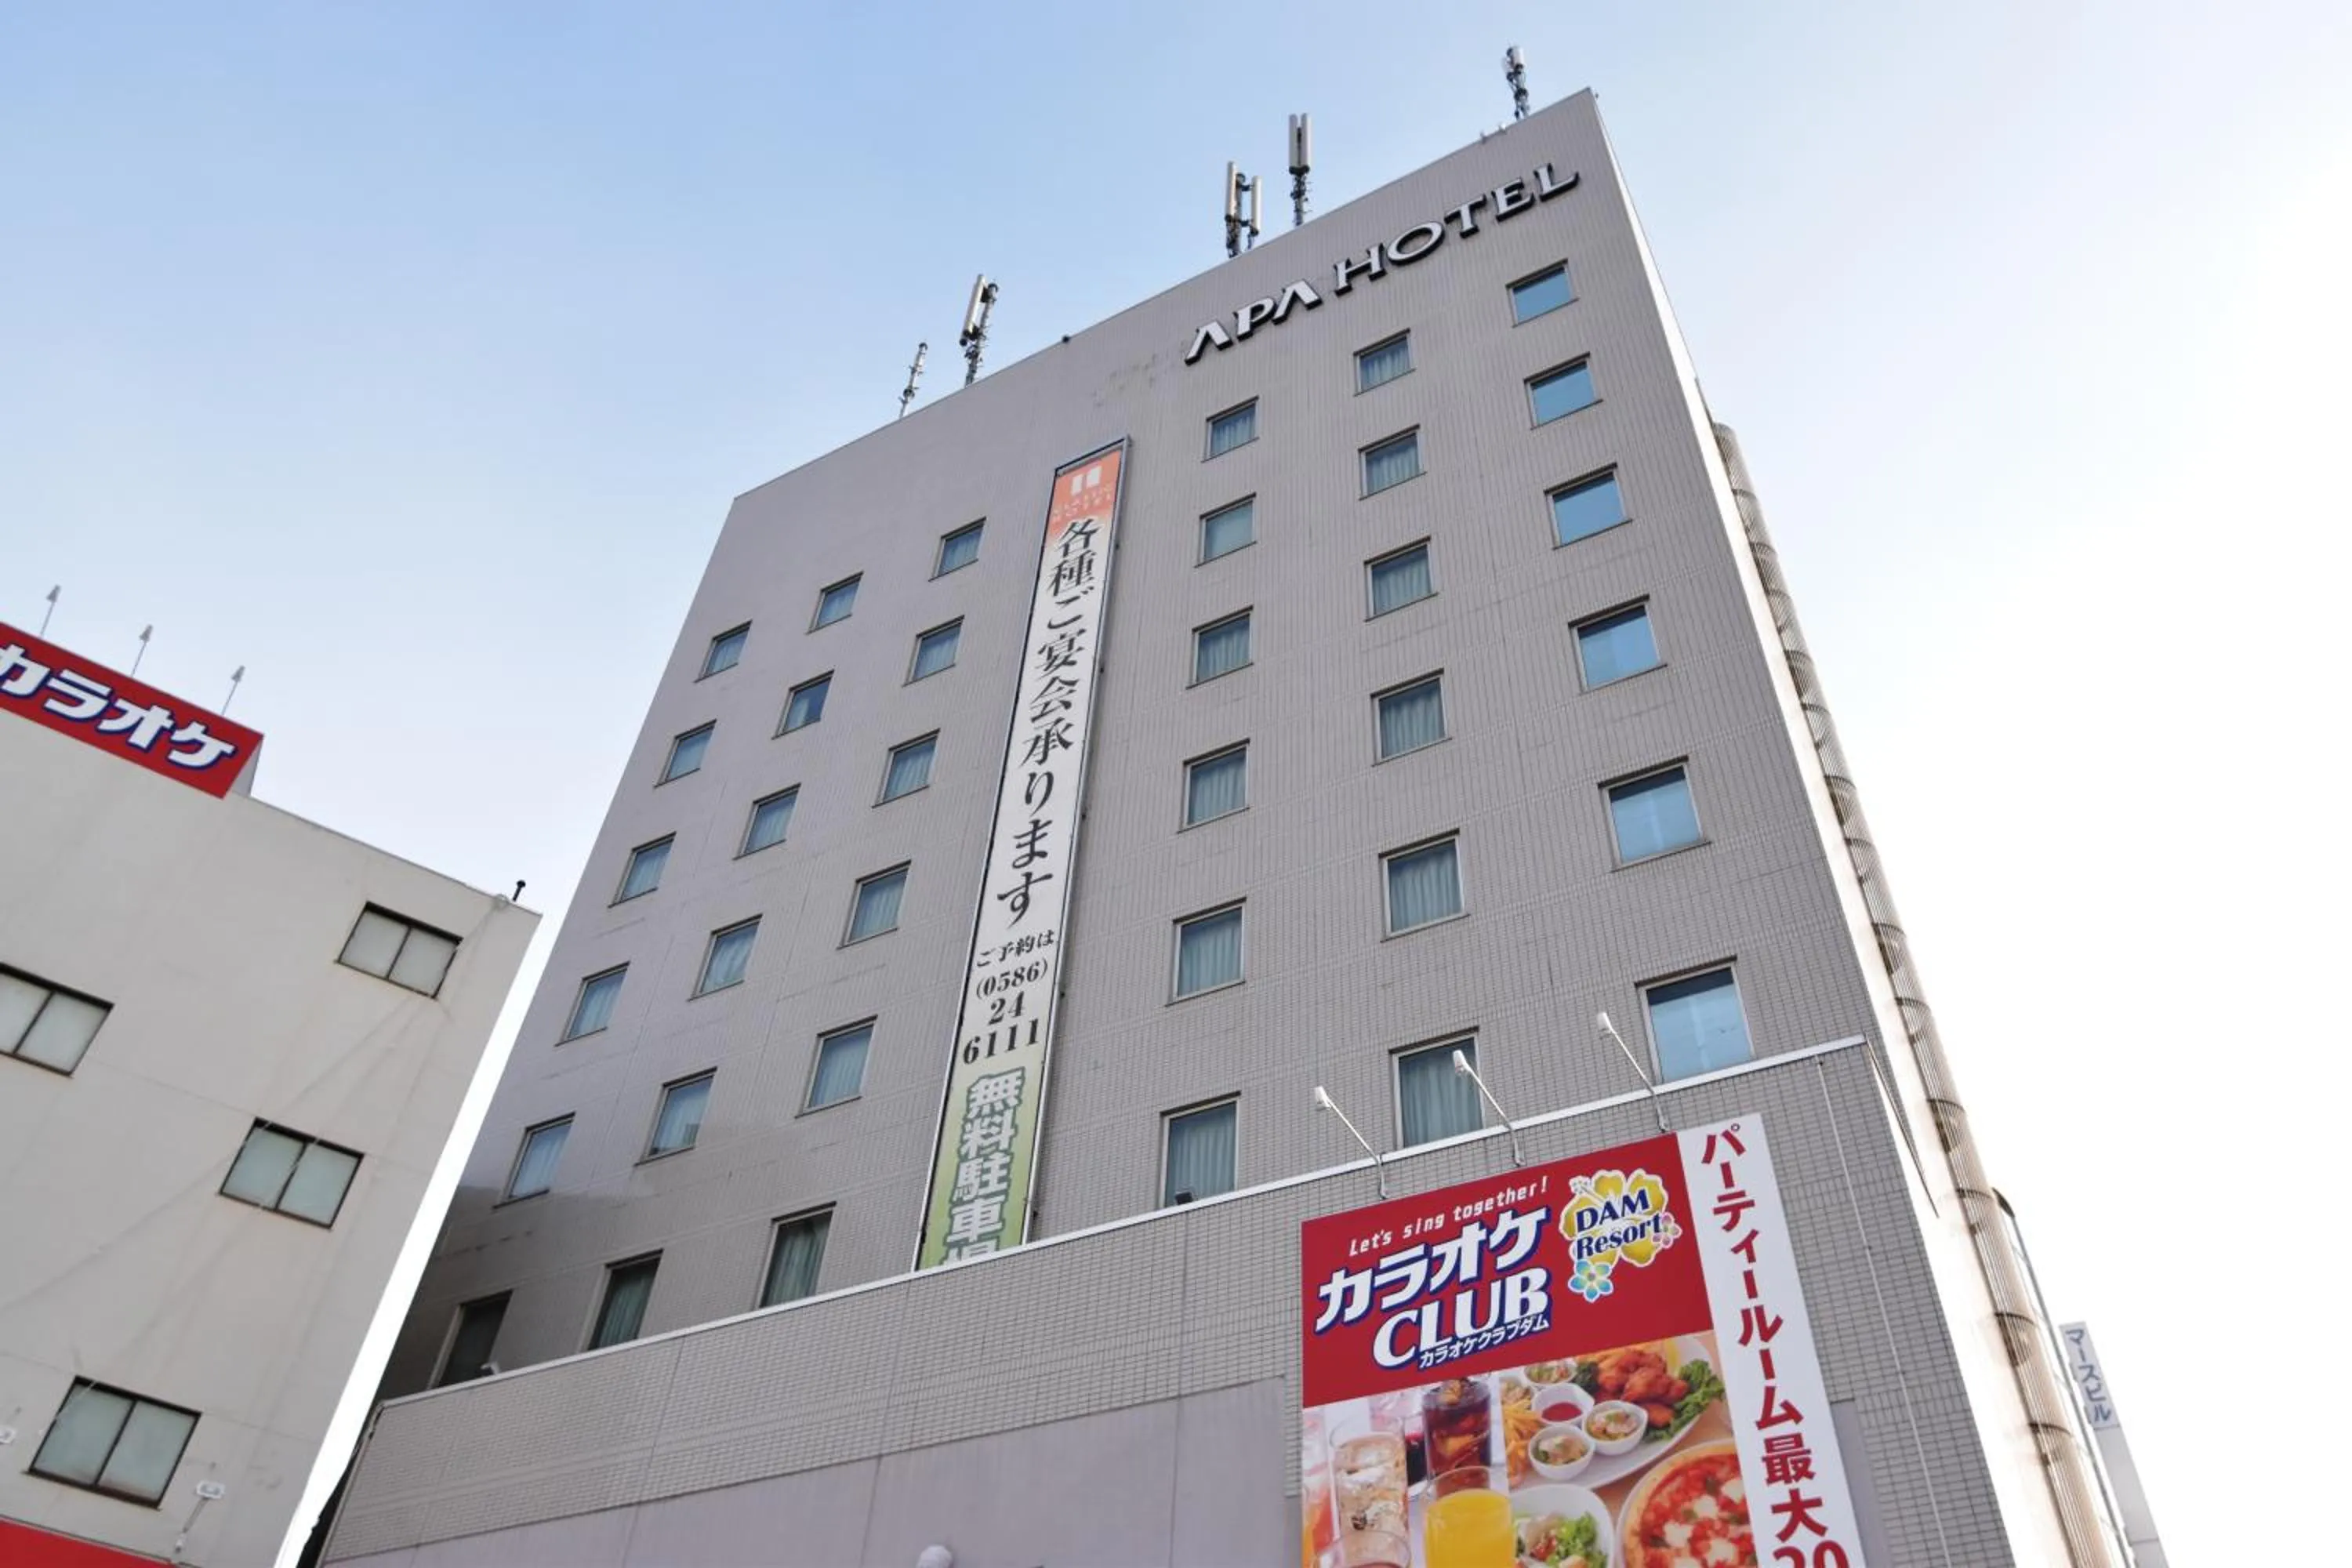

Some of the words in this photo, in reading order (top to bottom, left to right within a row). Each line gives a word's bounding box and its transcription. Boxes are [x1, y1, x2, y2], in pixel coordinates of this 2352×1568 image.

[1185, 278, 1323, 365] APA
[1333, 162, 1580, 296] HOTEL
[0, 643, 238, 770] カラオケ
[996, 518, 1101, 930] 各種ご宴会承ります
[976, 957, 1048, 1000] (0586)
[977, 929, 1054, 967] ご予約は
[963, 1018, 1040, 1065] 6111
[988, 991, 1025, 1025] 24
[1349, 1229, 1393, 1257] Let's
[1403, 1213, 1445, 1240] sing
[1453, 1175, 1548, 1222] together!
[1576, 1188, 1650, 1233] DAM
[1577, 1212, 1661, 1260] Resort
[1315, 1206, 1551, 1334] カラオケ
[1373, 1267, 1551, 1370] CLUB
[1419, 1313, 1550, 1369] カラオケクラブダム
[2065, 1329, 2111, 1422] マースビル
